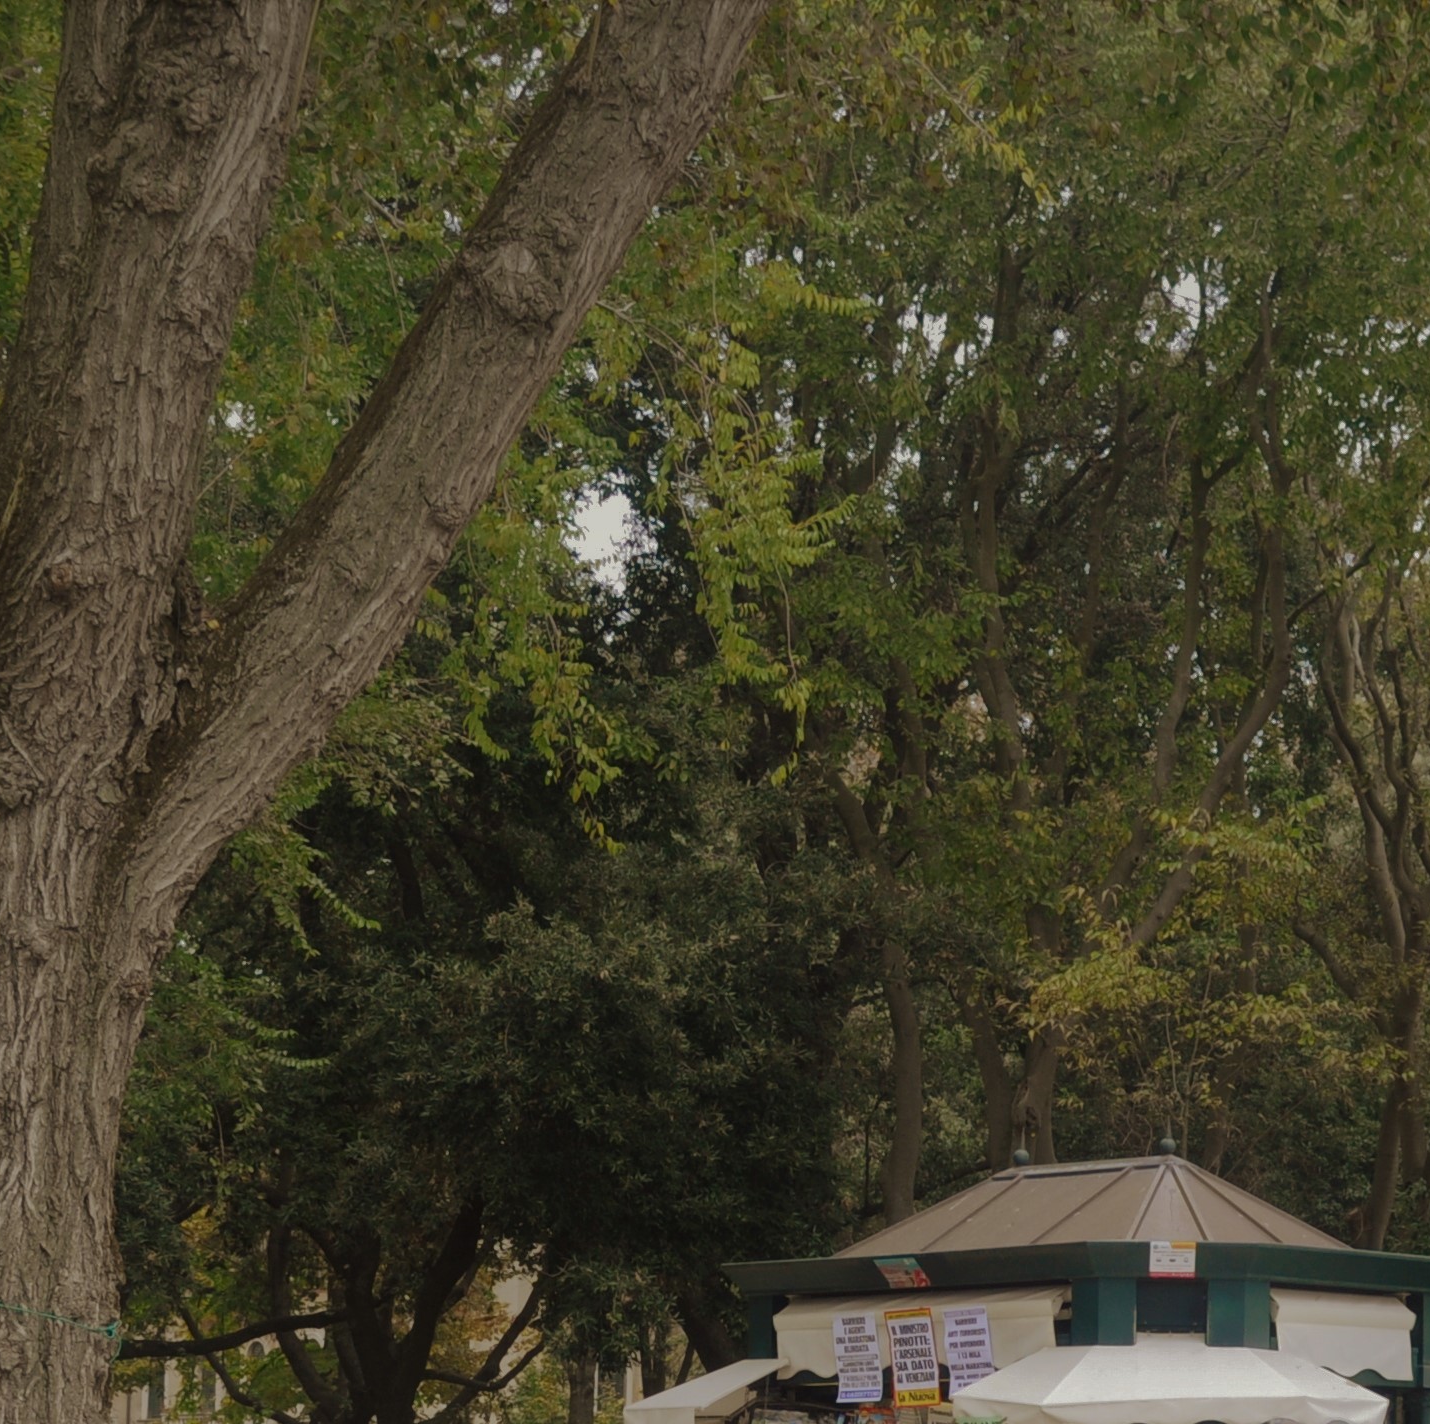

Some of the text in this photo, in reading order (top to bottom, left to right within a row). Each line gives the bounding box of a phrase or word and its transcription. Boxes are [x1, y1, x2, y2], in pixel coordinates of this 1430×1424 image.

[899, 1323, 929, 1334] MINISTRO
[894, 1335, 930, 1348] PINOTTI:
[894, 1347, 932, 1360] L'ARSENALE
[895, 1359, 934, 1372] SIA DATO
[905, 1371, 935, 1383] VENEZIANI
[898, 1391, 936, 1402] la Nuova
